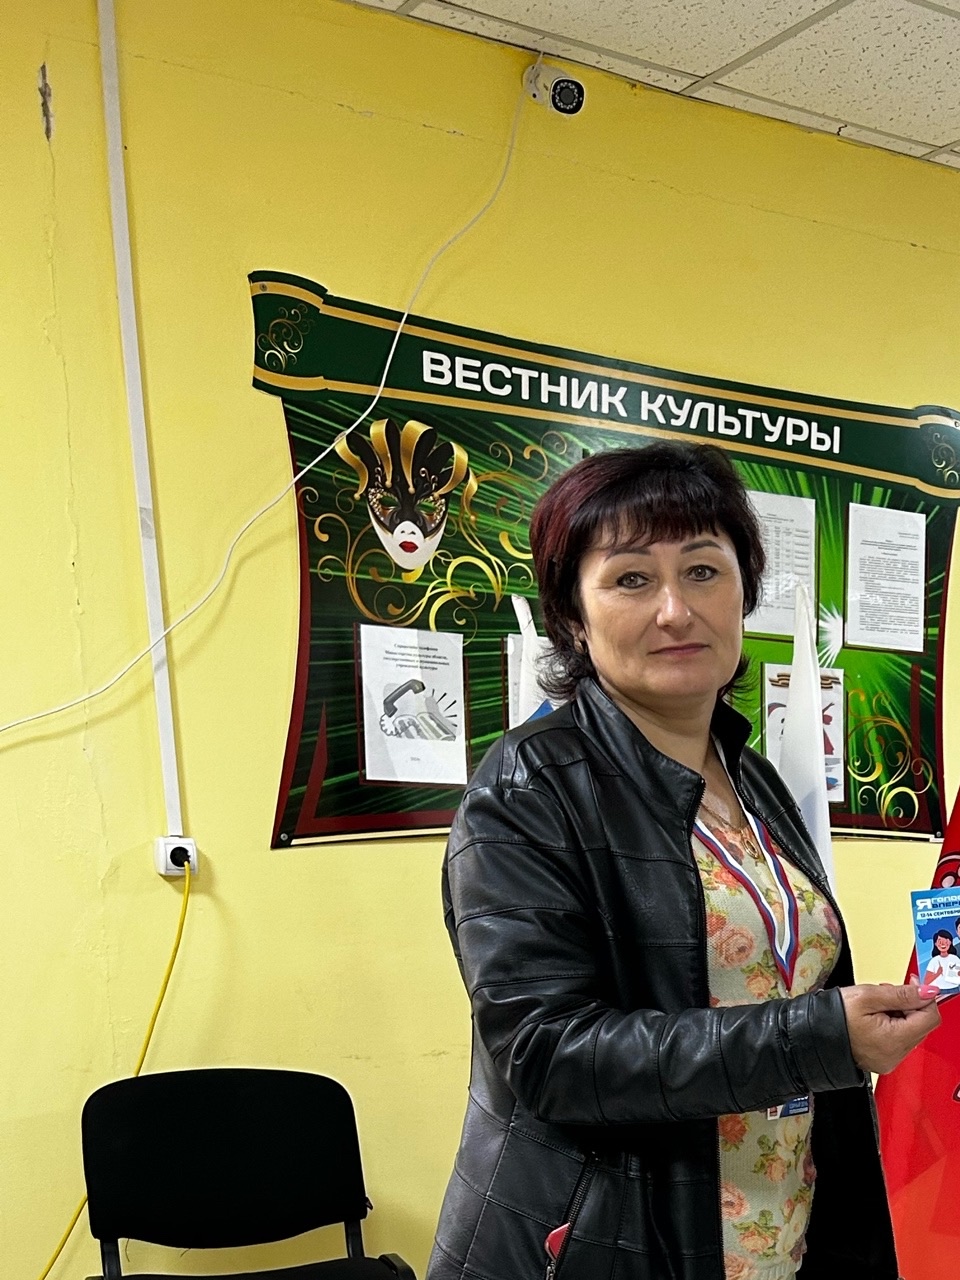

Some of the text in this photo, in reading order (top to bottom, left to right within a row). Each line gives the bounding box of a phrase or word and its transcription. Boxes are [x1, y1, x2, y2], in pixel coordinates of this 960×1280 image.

[422, 350, 841, 454] ВЕСТНИК КУЛЬТУРЫ
[916, 898, 932, 910] Я
